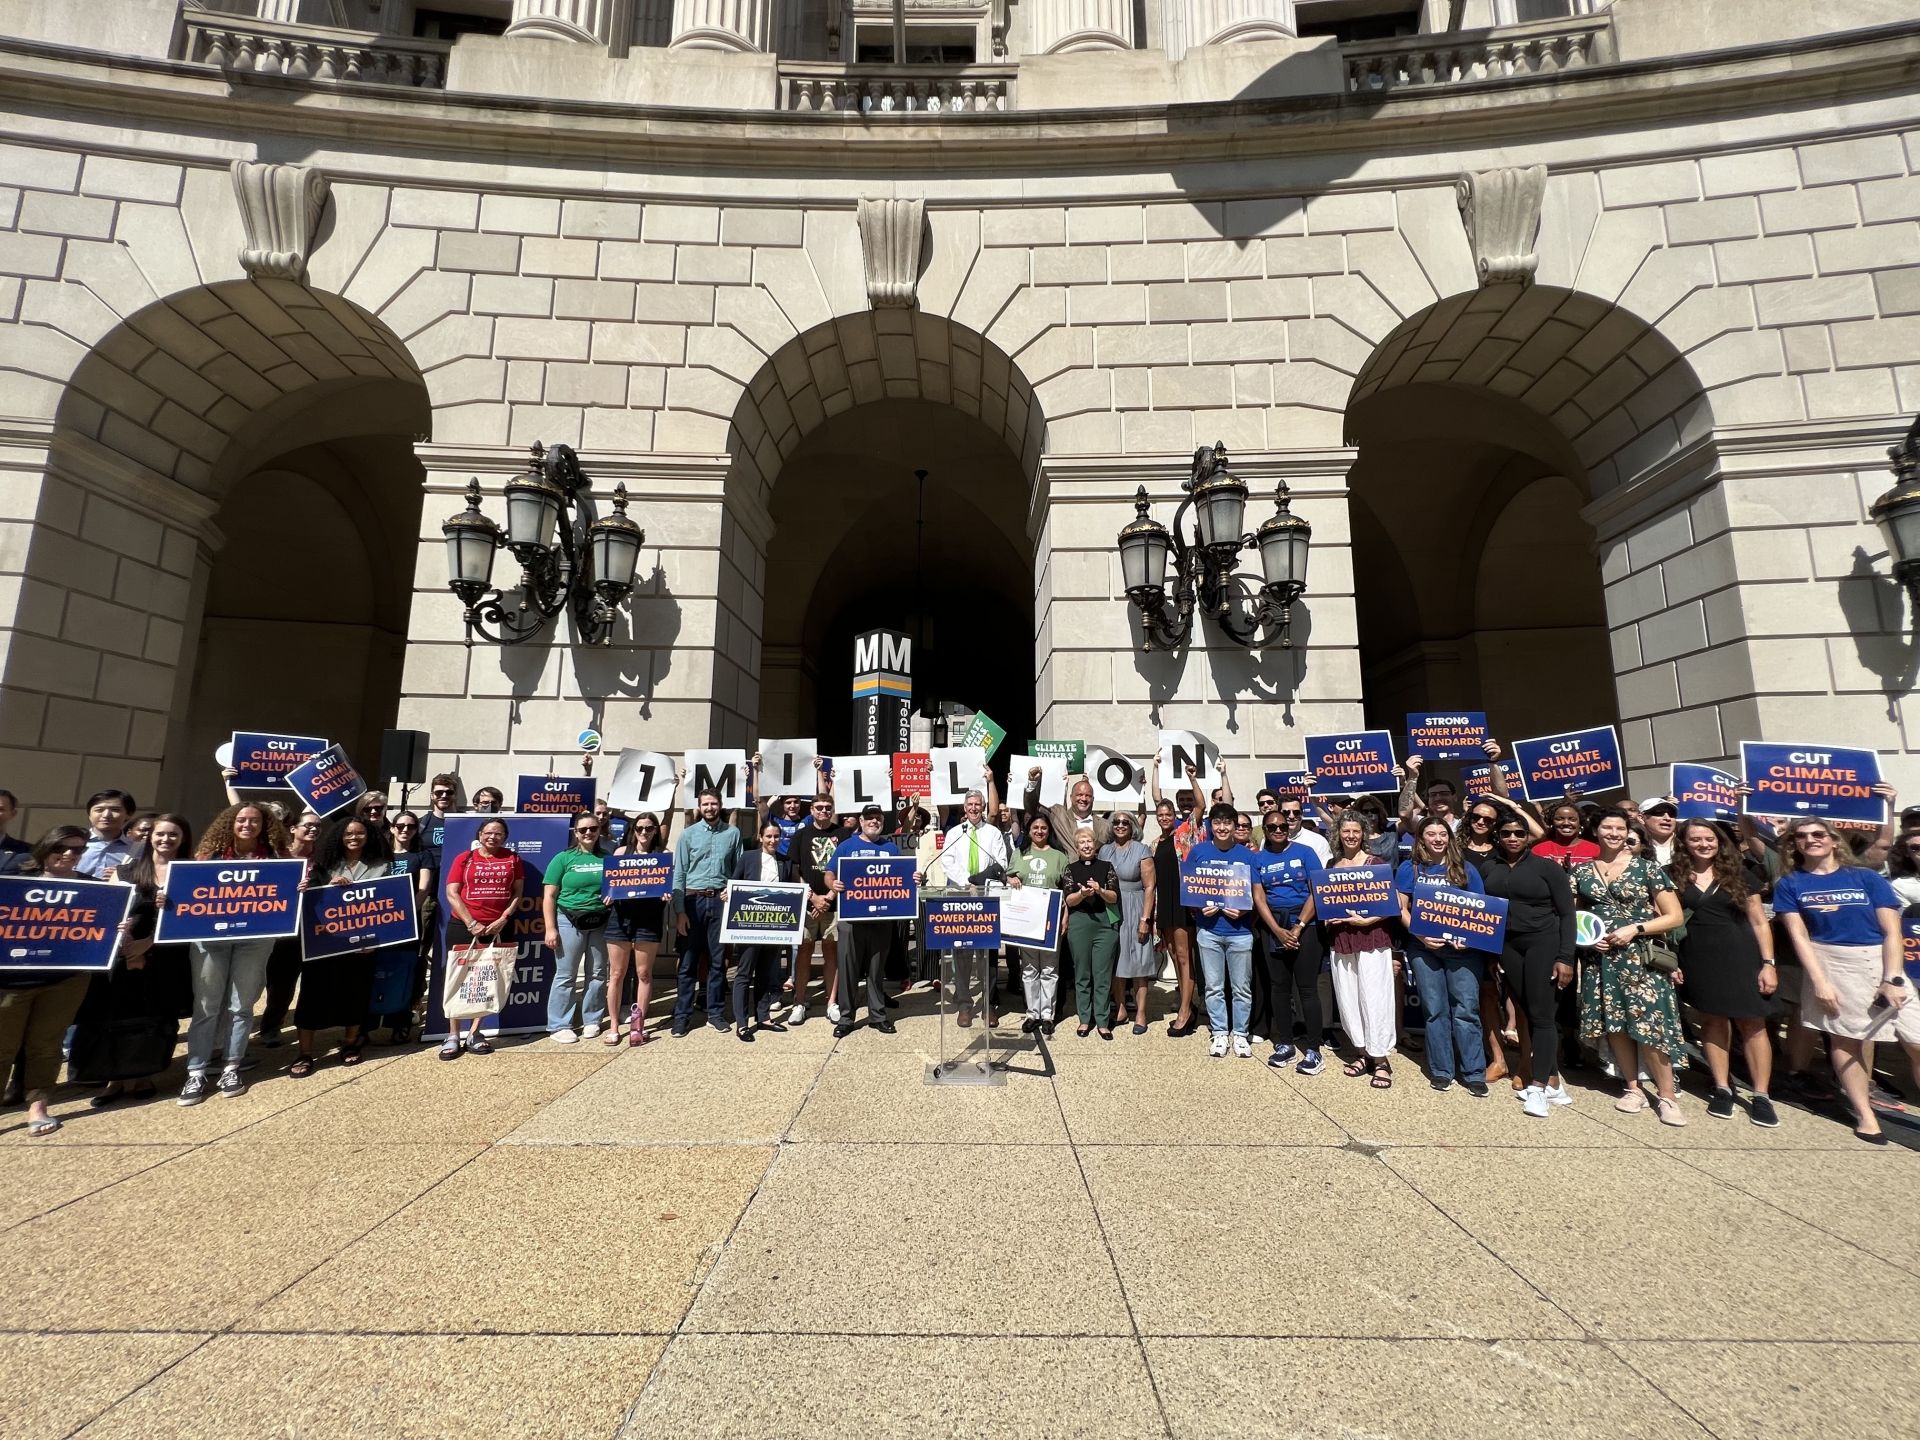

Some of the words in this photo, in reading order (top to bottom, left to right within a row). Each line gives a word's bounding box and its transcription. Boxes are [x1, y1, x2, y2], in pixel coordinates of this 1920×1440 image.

[855, 633, 879, 674] M
[881, 633, 912, 674] M
[867, 695, 878, 755] Federal
[899, 698, 911, 752] Federa
[1425, 717, 1470, 726] STRONG
[1411, 729, 1450, 737] POWER
[1452, 727, 1485, 735] PLANT
[267, 741, 296, 751] CUT
[1034, 743, 1077, 752] CLIMATE
[1336, 740, 1362, 751] CUT
[1416, 737, 1482, 747] STANDARDS
[1550, 740, 1580, 754] CUT
[251, 751, 311, 762] CLIMATE
[315, 754, 337, 770] CUT
[1323, 751, 1379, 764] CLIMATE
[1538, 750, 1601, 768] CLIMATE
[1789, 752, 1832, 765] CUT
[1316, 763, 1388, 777] POLLUTION
[1532, 761, 1612, 782] POLLUTION
[1769, 766, 1857, 781] CLIMATE
[638, 764, 656, 802] 1
[1289, 775, 1304, 784] CU
[1712, 774, 1738, 788] CU
[544, 782, 569, 792] CUT
[1758, 780, 1870, 798] POLLUTION
[531, 792, 581, 803] CLIMATE
[523, 803, 588, 813] POLLUTION
[619, 858, 658, 867] STRONG
[217, 869, 260, 882] CUT
[605, 868, 640, 877] POWER
[640, 866, 670, 875] PLANT
[866, 864, 891, 875] CUT
[1195, 867, 1234, 877] STRONG
[609, 877, 666, 887] STANDARDS
[853, 877, 902, 888] CLIMATE
[1183, 875, 1217, 886] POWER
[1218, 878, 1248, 887] PLANT
[1329, 871, 1374, 882] STRONG
[192, 885, 278, 899] CLIMATE
[1187, 886, 1244, 897] STANDARDS
[1316, 883, 1355, 894] POWER
[1357, 880, 1391, 891] PLANT
[25, 889, 79, 904] CUT
[342, 887, 377, 902] CUT
[846, 889, 910, 900] POLLUTION
[1322, 892, 1389, 905] STANDARDS
[1434, 891, 1486, 909] STRONG
[176, 900, 288, 916] POLLUTION
[324, 898, 395, 919] CLIMATE
[740, 904, 792, 912] ENVIRONMENT
[942, 902, 984, 912] STRONG
[1416, 899, 1460, 916] POWER
[1462, 908, 1503, 925] PLANT
[315, 910, 405, 936] POLLUTION
[731, 910, 797, 924] AMERICA
[929, 914, 964, 923] POWER
[966, 913, 997, 922] PLANT
[1420, 911, 1495, 936] STANDARDS
[0, 924, 106, 941] LLUTION
[933, 924, 994, 934] STANDARDS
